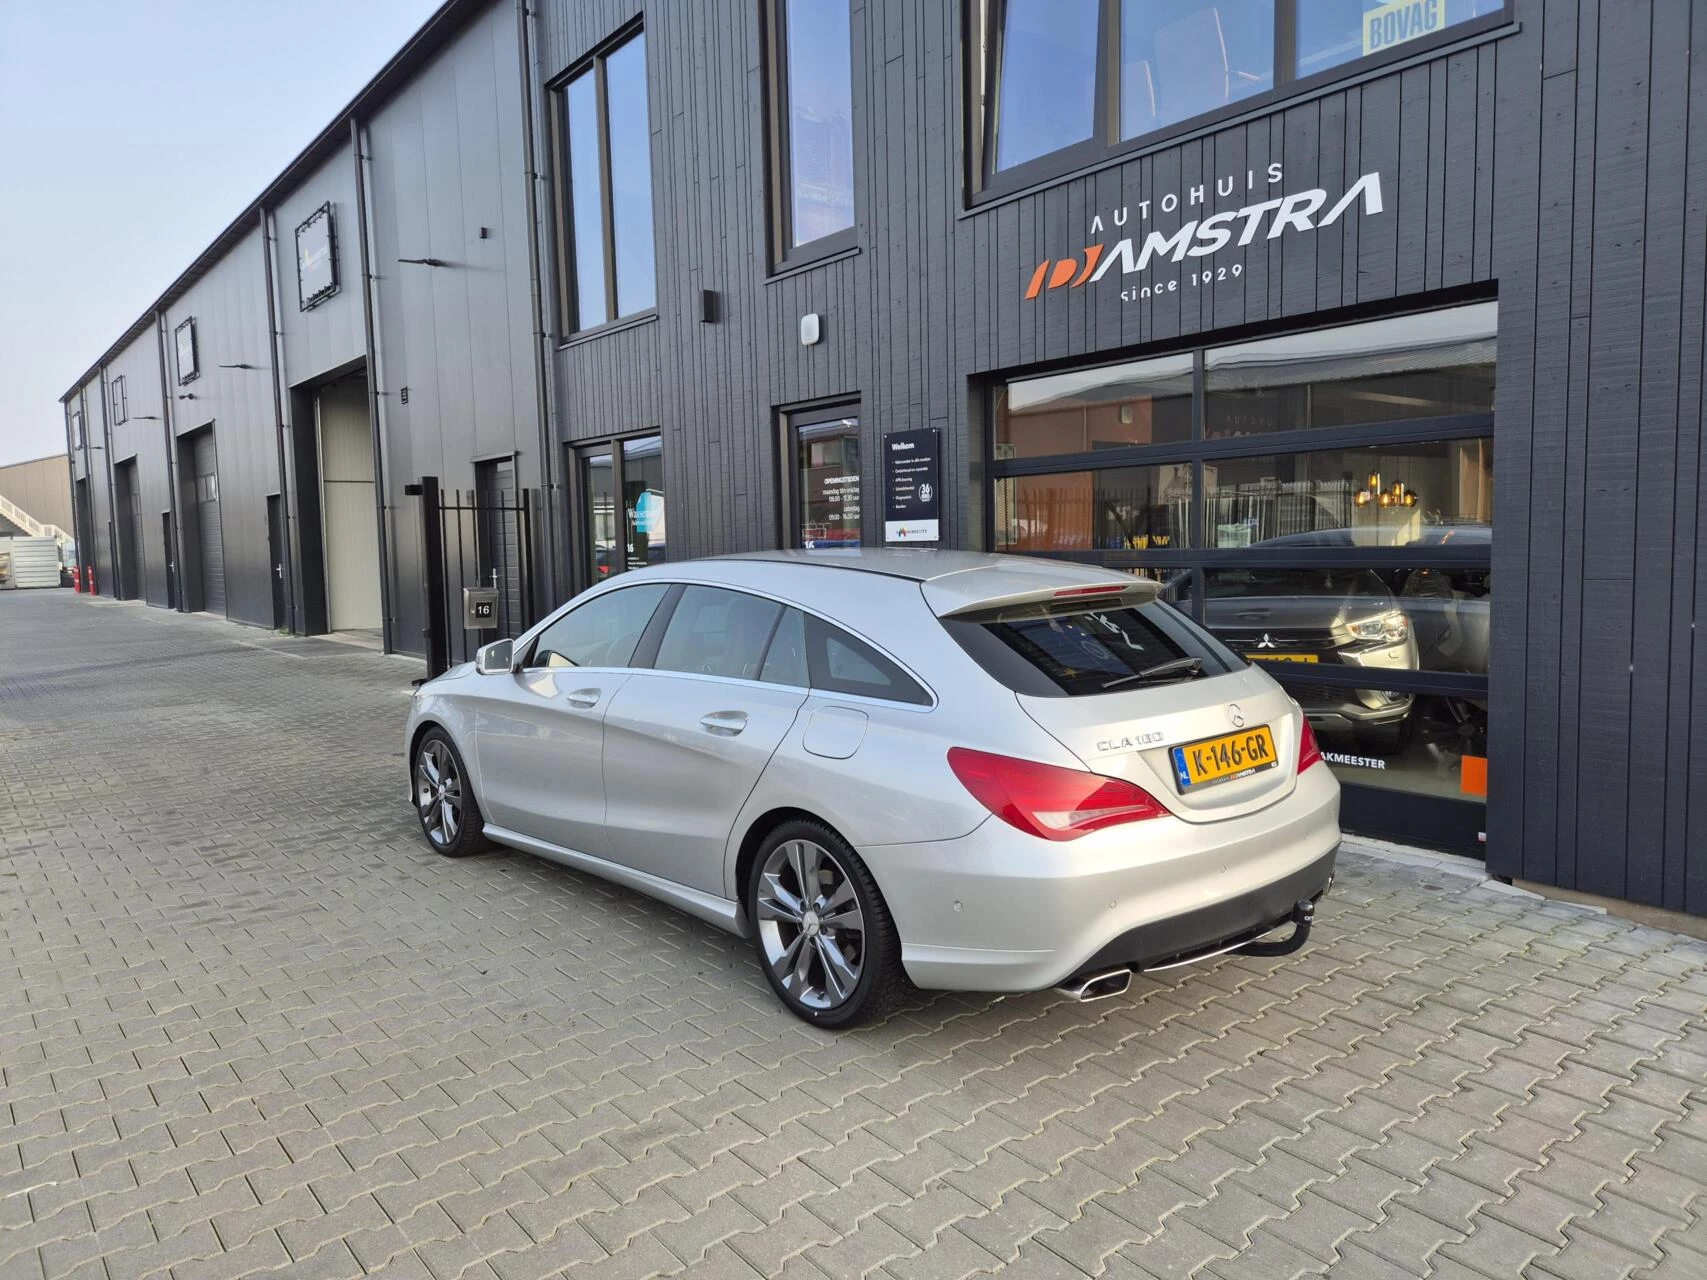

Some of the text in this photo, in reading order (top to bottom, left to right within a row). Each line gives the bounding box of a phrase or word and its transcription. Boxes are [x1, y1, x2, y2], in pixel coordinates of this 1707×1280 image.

[1370, 0, 1437, 50] BOVAG
[1091, 163, 1282, 234] AUTOHUIS
[1120, 263, 1243, 302] since 1929
[891, 442, 914, 450] Welkom
[921, 483, 930, 494] 36
[627, 544, 634, 552] 16
[477, 605, 490, 615] 16
[1097, 737, 1133, 751] CLA
[1192, 733, 1269, 777] K-146-GR
[1180, 771, 1189, 780] NL
